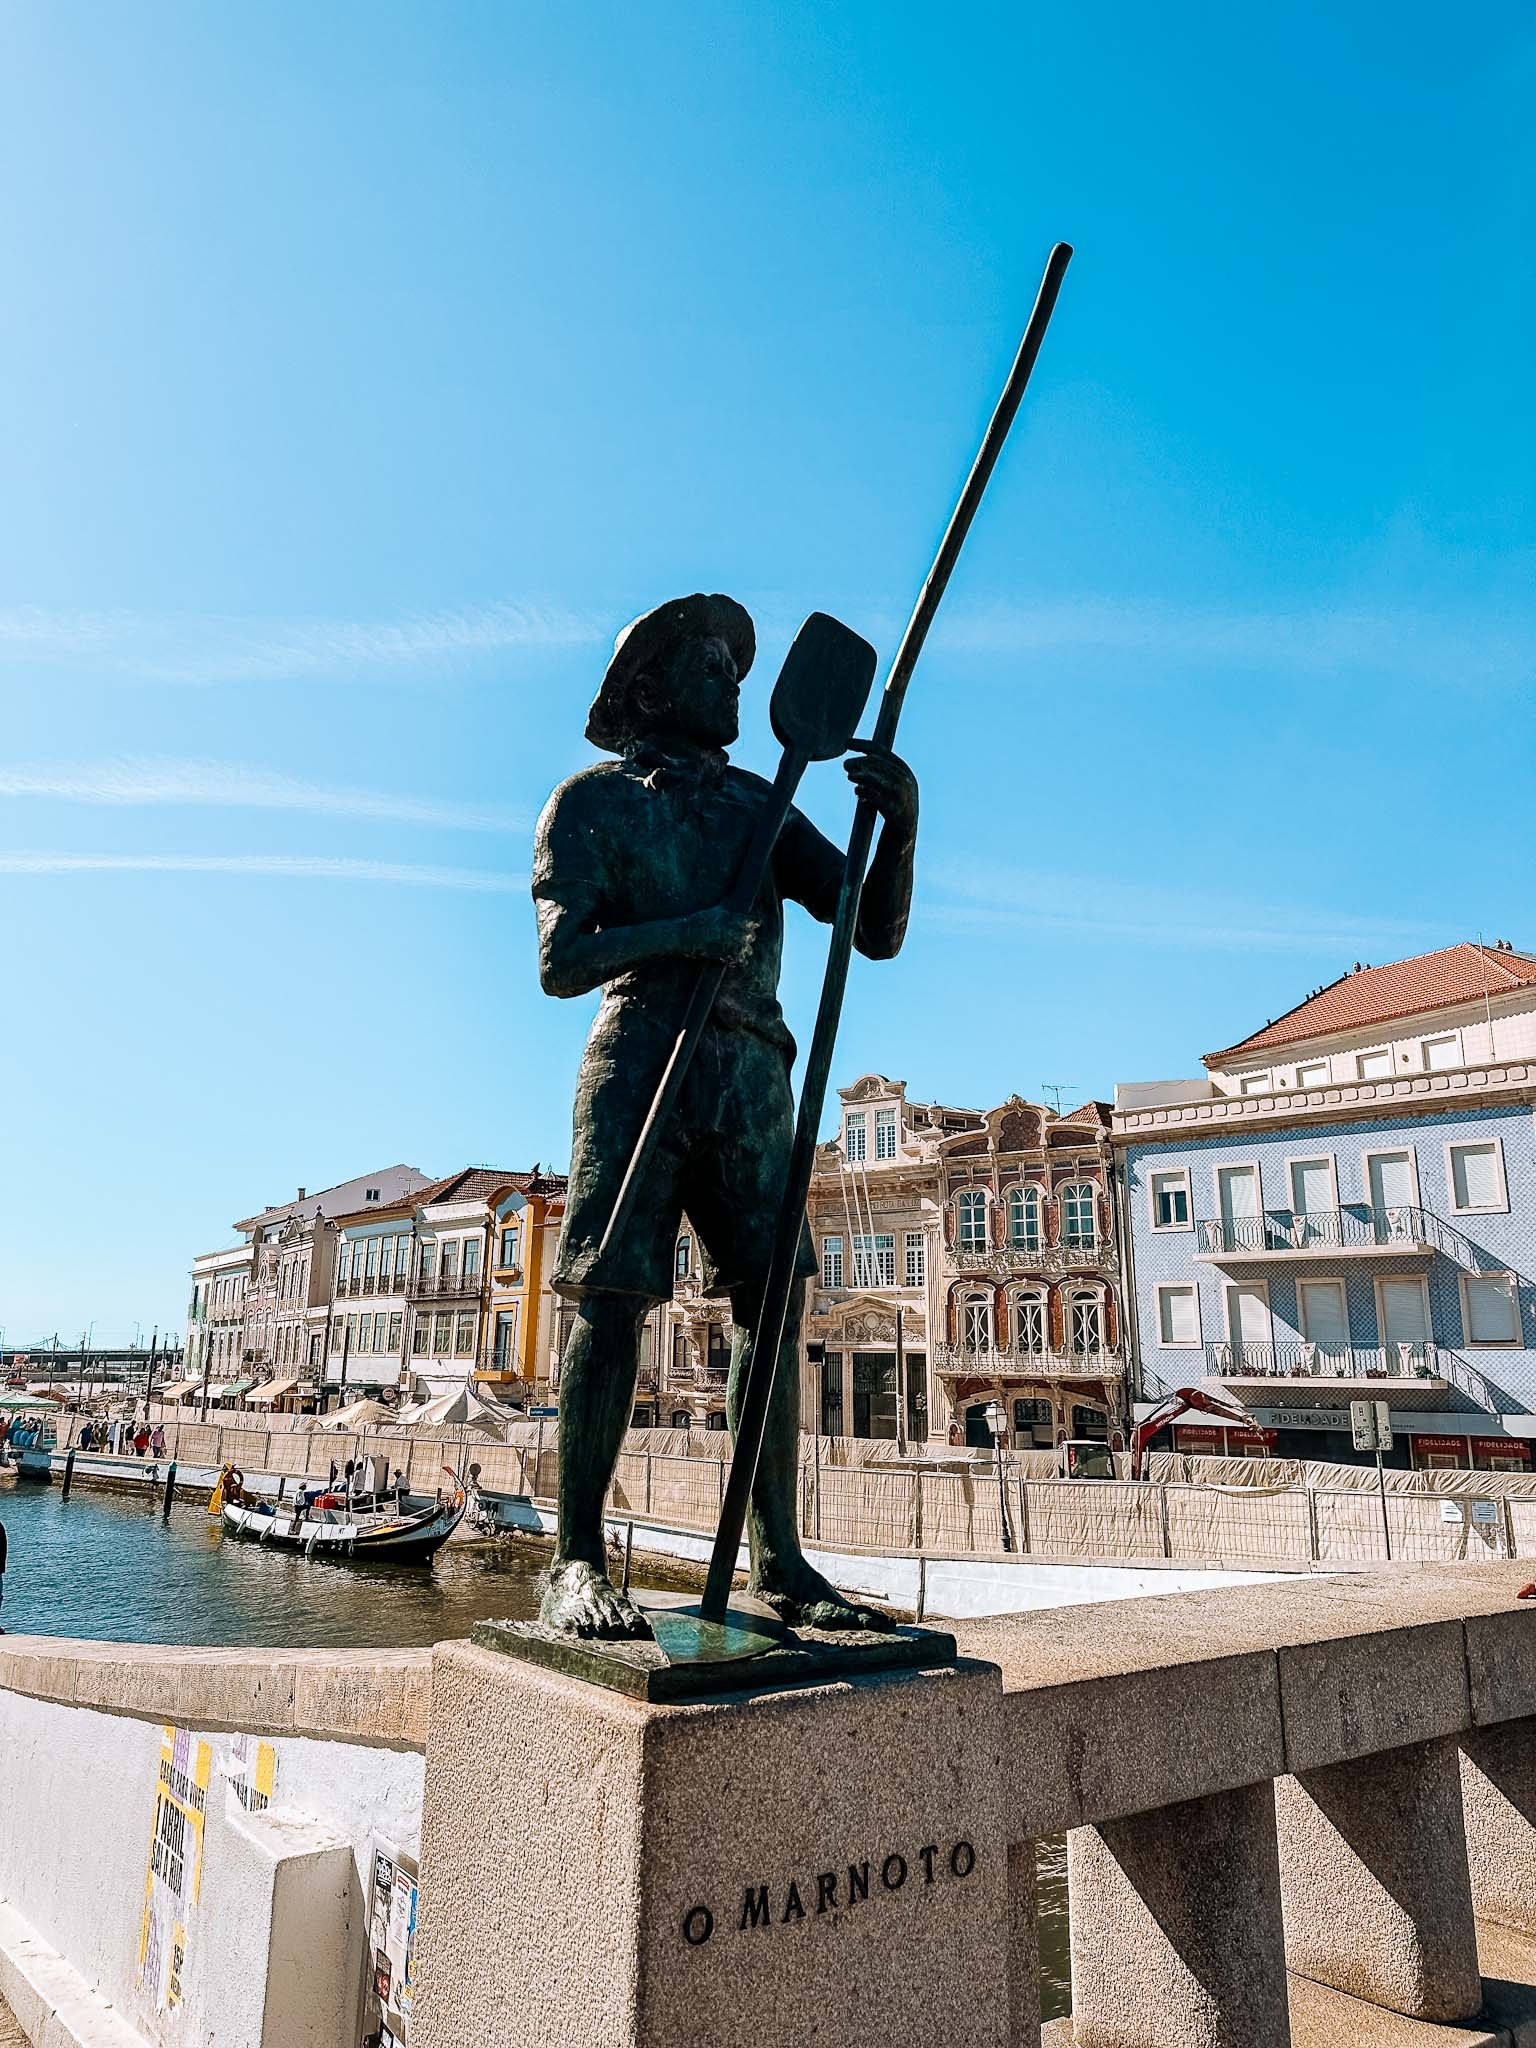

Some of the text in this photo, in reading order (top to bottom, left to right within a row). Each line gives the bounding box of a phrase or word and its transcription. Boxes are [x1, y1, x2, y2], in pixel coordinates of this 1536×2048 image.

[1270, 1412, 1350, 1427] FIDELIDADE
[1417, 1438, 1462, 1447] FIDELIDADE
[1479, 1440, 1524, 1449] FIDELIDADE
[160, 1797, 185, 1860] ABRIL
[168, 1854, 184, 1898] RUA
[682, 1840, 977, 1946] O MARNOTO
